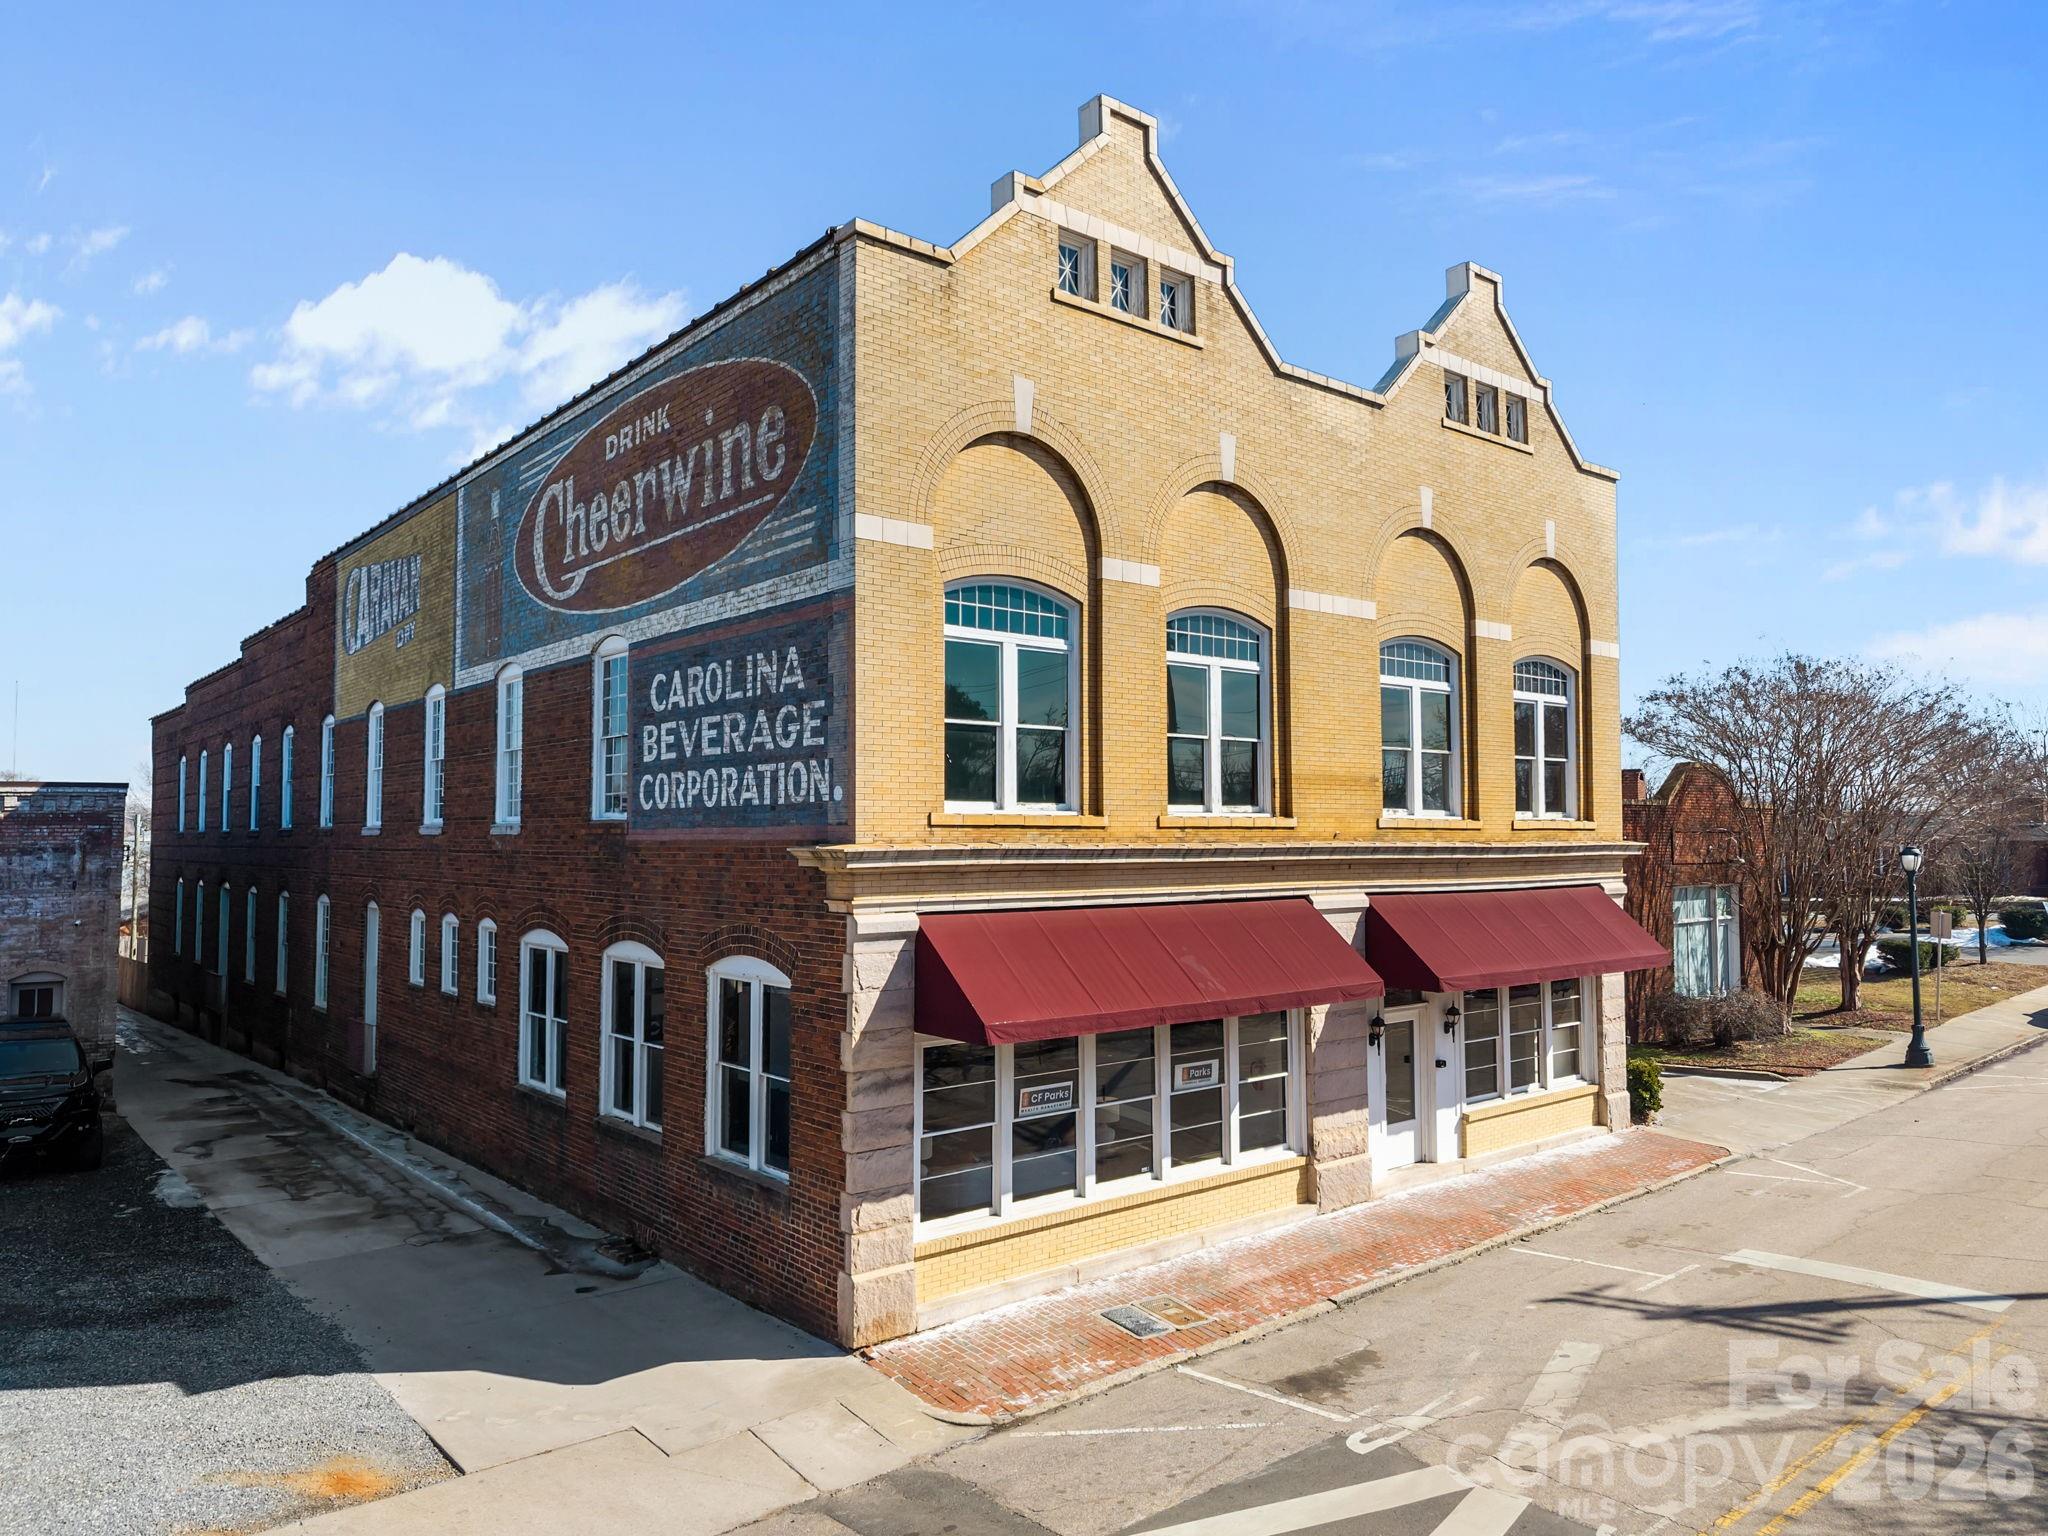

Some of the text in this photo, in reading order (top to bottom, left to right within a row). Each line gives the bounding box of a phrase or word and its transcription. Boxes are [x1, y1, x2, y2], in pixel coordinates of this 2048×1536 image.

[605, 403, 672, 461] DRINK
[533, 405, 786, 600] Cheerwine
[650, 645, 805, 713] CAROLINA
[643, 699, 826, 762] BEVERAGE
[639, 758, 843, 810] CORPORATION.
[1031, 1089, 1070, 1103] CF Parks
[1190, 1067, 1211, 1078] Parks
